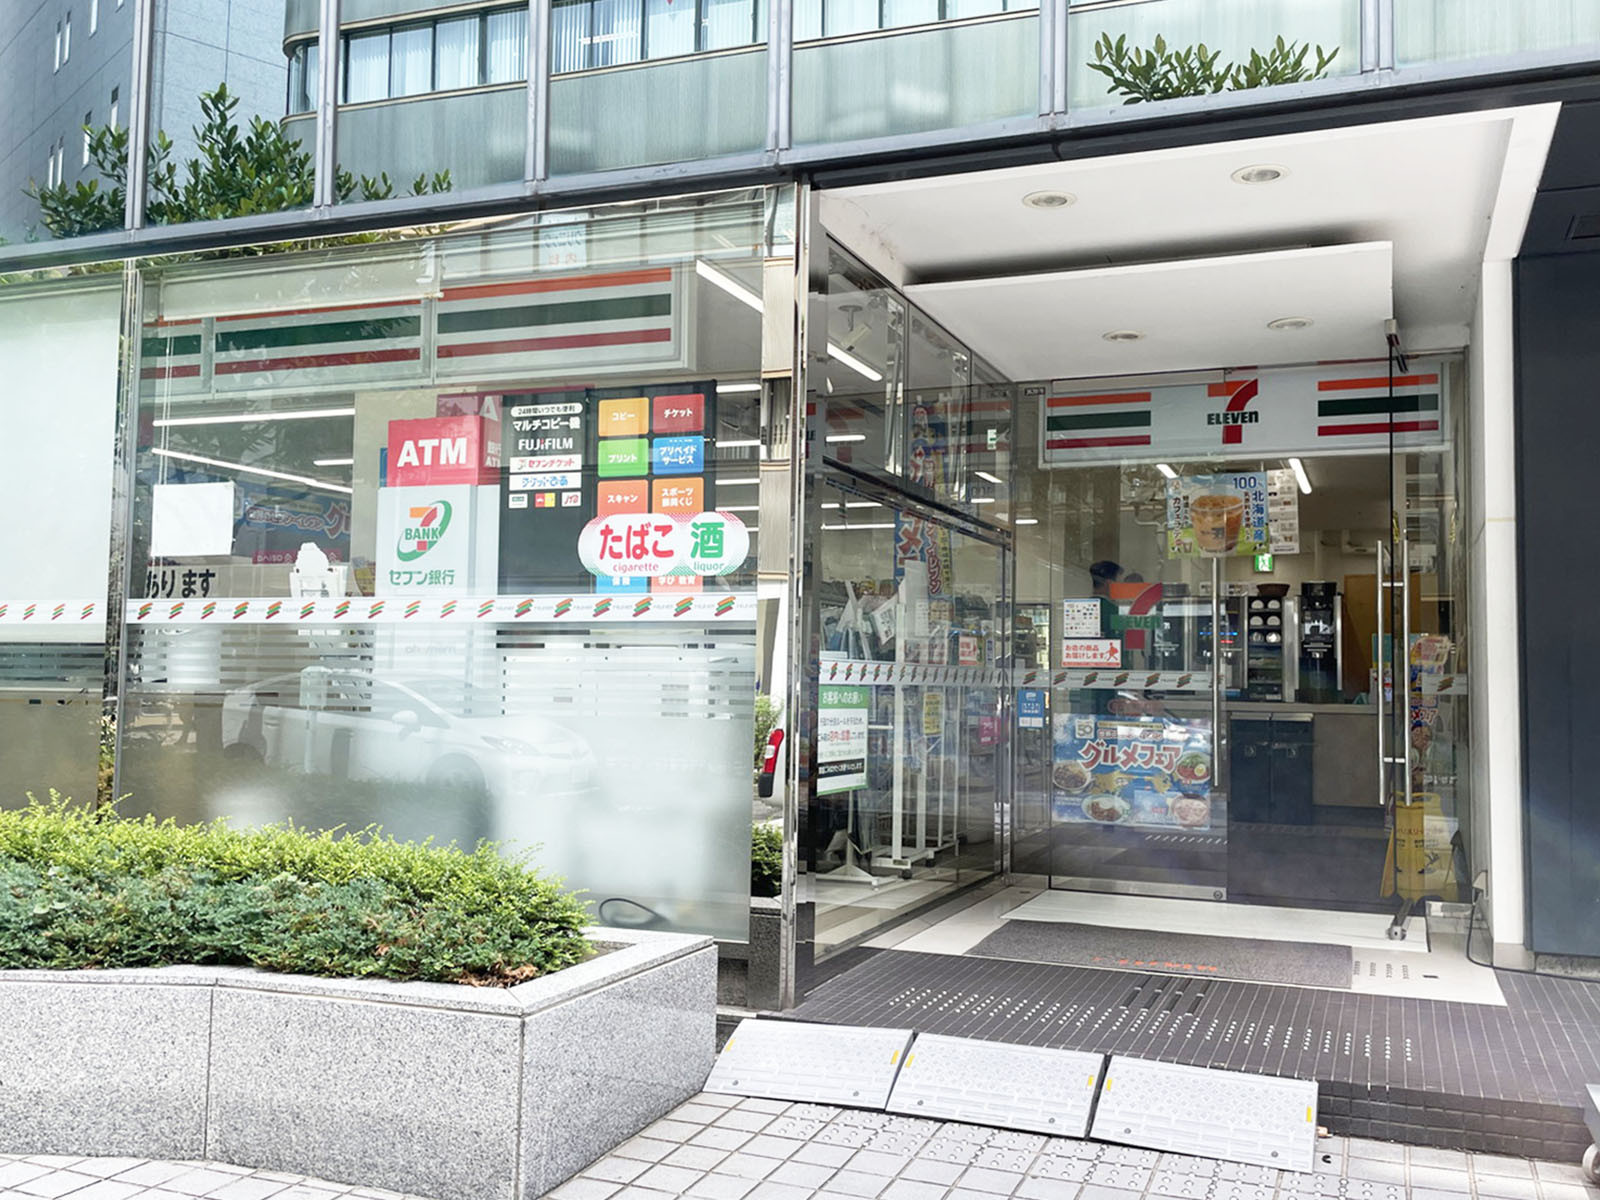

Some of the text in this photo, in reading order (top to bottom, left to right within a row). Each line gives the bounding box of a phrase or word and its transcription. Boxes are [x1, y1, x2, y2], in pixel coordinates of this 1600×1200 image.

[612, 412, 636, 421] コピー
[664, 408, 693, 418] チケット
[1208, 378, 1258, 444] 7
[512, 416, 581, 431] マルチコピー機
[518, 437, 573, 450] FUJIFILM
[659, 445, 697, 455] プリペイド
[396, 437, 467, 467] ATM
[608, 454, 638, 463] プリント
[662, 455, 694, 465] サービス
[607, 494, 638, 504] スキャン
[404, 527, 439, 541] BANK
[599, 521, 725, 560] たばこ 酒
[613, 561, 725, 573] cigarette liquor
[389, 569, 455, 585] セブン銀行
[1080, 740, 1182, 774] グルメフェア
